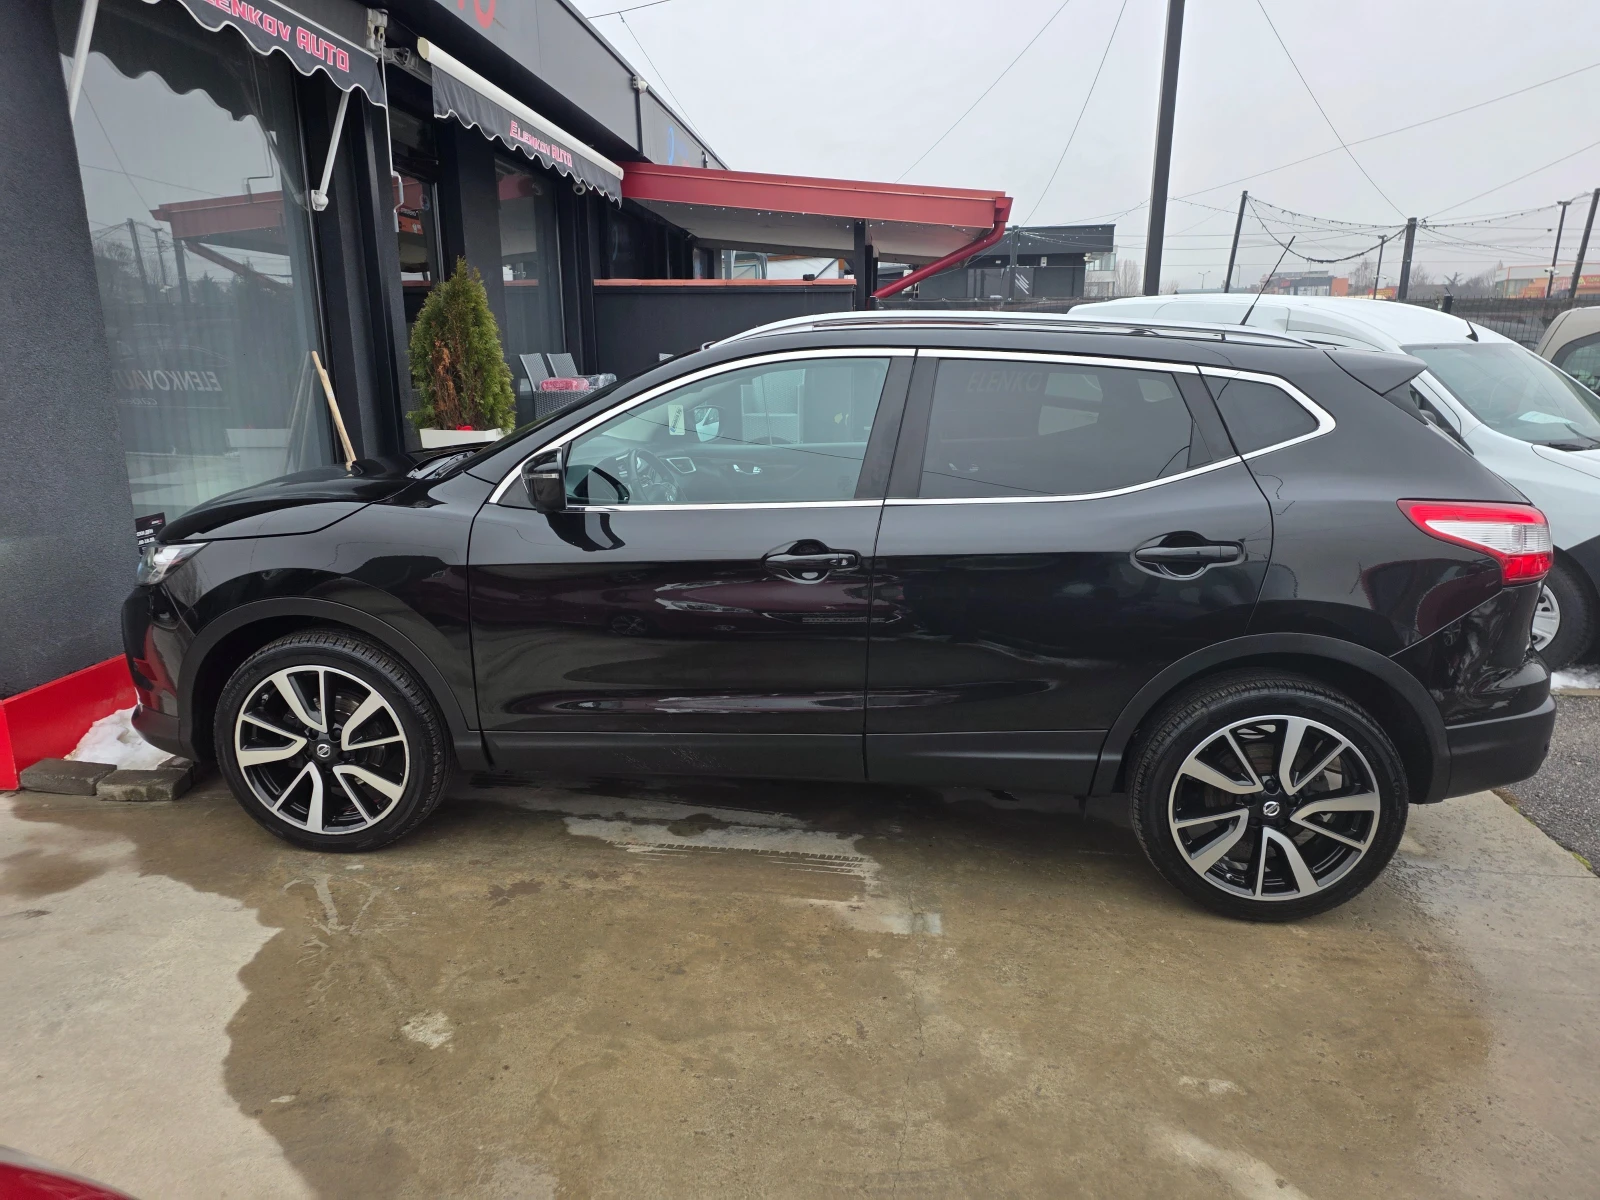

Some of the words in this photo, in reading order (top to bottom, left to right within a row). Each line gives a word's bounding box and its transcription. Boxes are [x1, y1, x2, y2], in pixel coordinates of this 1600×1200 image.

[204, 0, 292, 42] ENKOV
[296, 26, 350, 73] AUTO
[551, 143, 573, 168] AUTO
